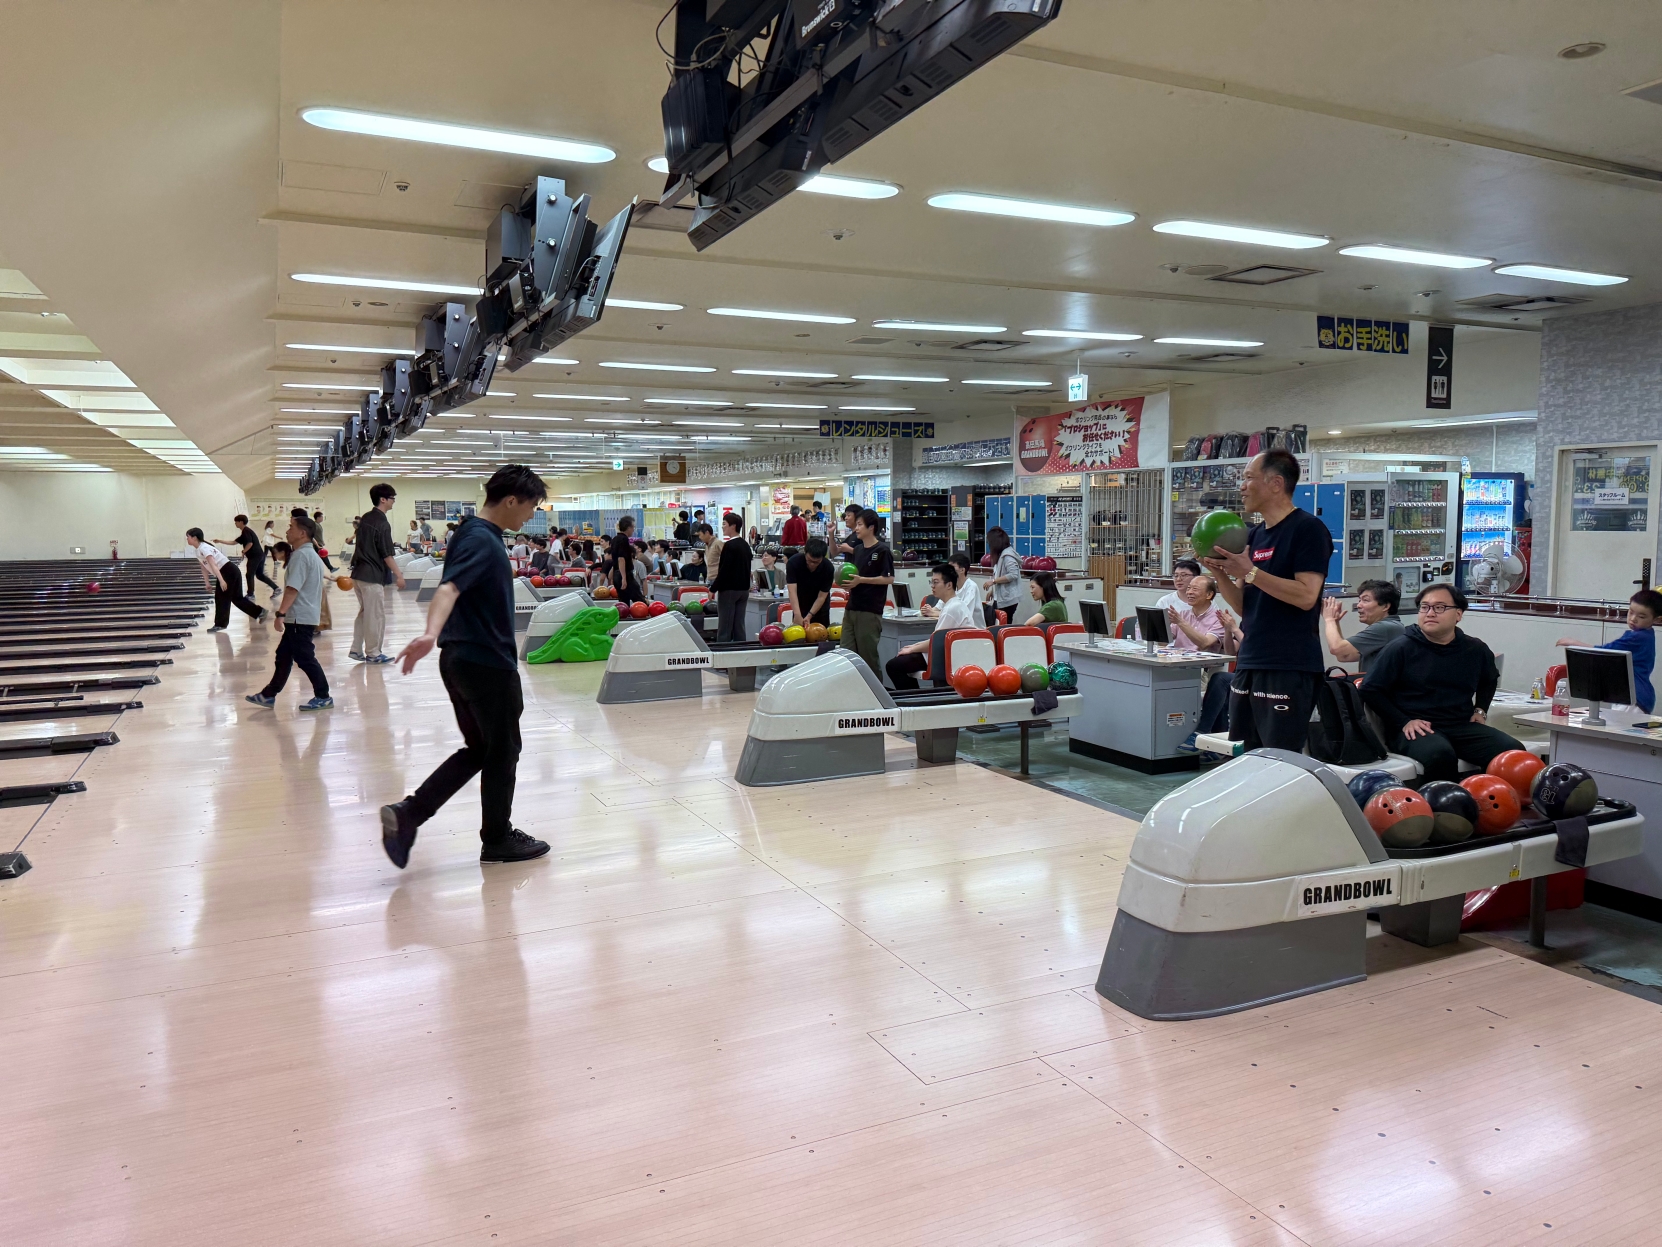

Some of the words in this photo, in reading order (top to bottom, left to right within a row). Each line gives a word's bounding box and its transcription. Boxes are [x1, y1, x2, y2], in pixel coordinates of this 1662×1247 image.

[802, 5, 830, 37] Brunswick
[1337, 322, 1408, 352] お手洗い
[832, 422, 924, 438] レンタルシューズ
[667, 656, 710, 666] GRANDBOWL
[838, 716, 895, 729] GRANDBOWL
[1303, 878, 1393, 906] GRANDBOWL
